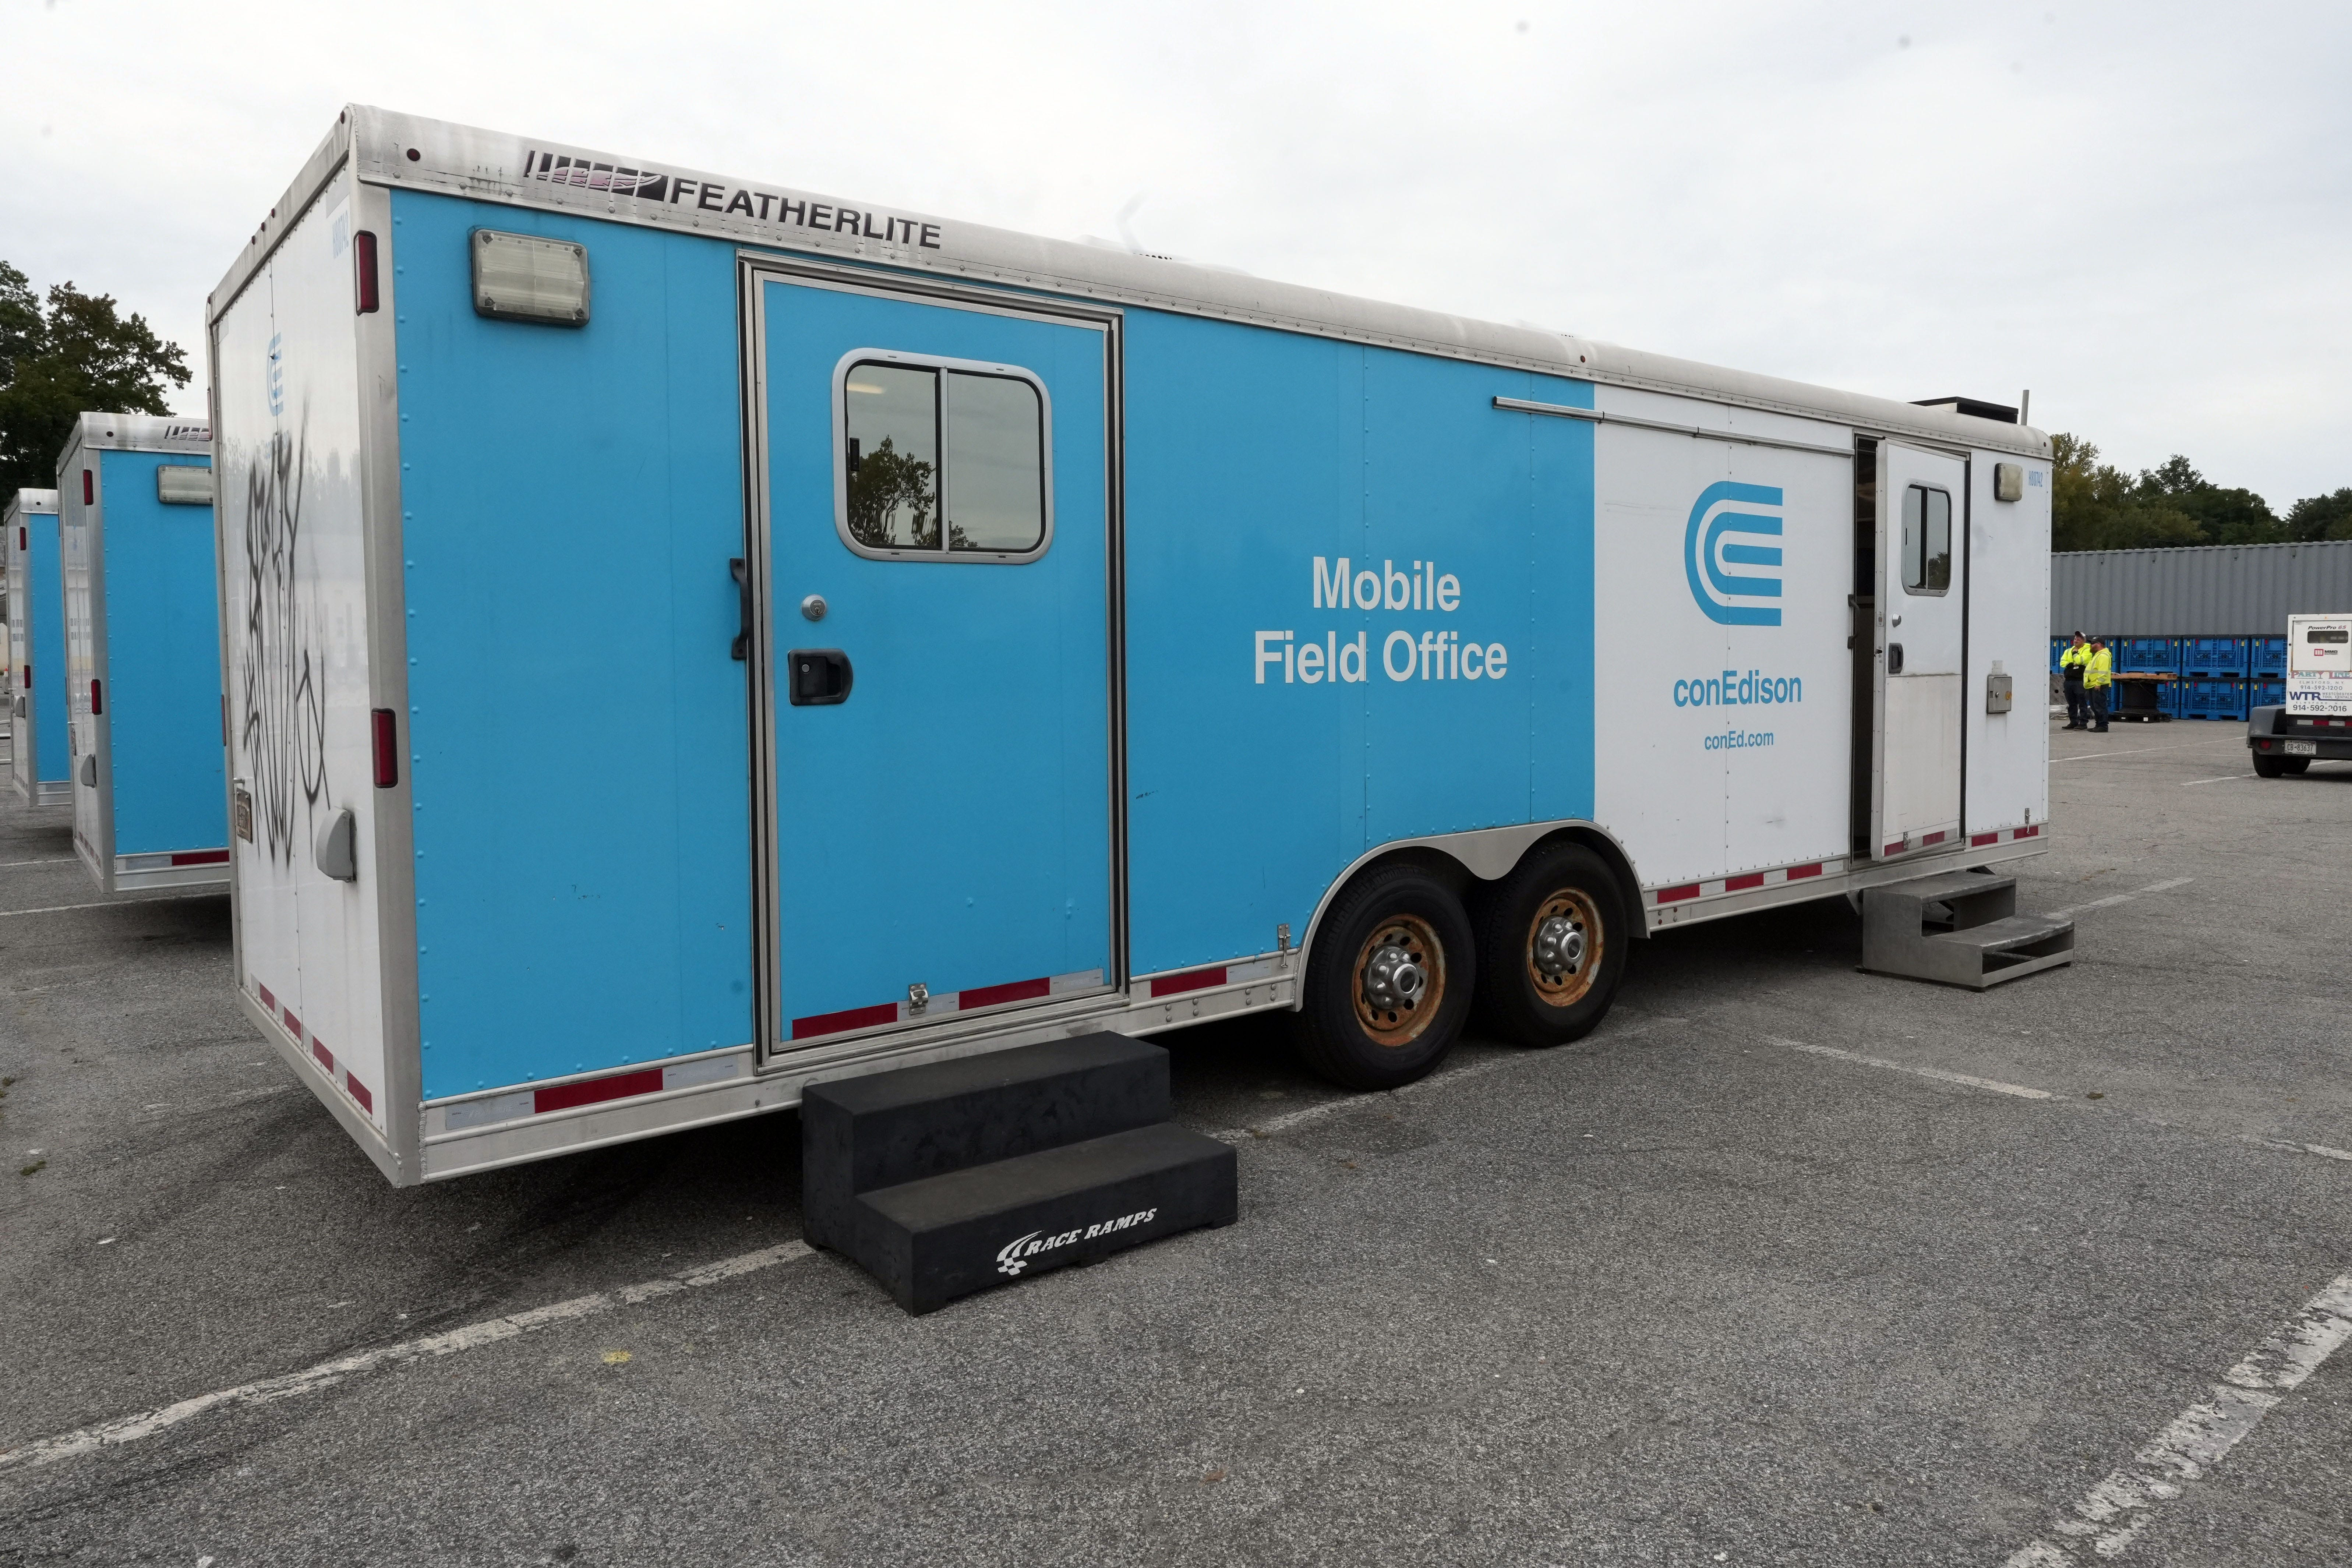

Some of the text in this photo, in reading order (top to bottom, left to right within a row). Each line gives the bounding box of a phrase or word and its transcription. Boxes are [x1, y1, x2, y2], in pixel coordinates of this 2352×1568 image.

[670, 177, 941, 249] FEATHERLITE
[2029, 471, 2043, 487] H80742
[1313, 556, 1460, 611] Mobile
[1255, 630, 1507, 684] Field Office
[2291, 671, 2323, 679] PARTY
[1674, 670, 1802, 707] conEdison
[2289, 691, 2321, 700] WTR
[1704, 731, 1774, 750] conEd.com
[1024, 1208, 1158, 1257] RACE RAMPS
